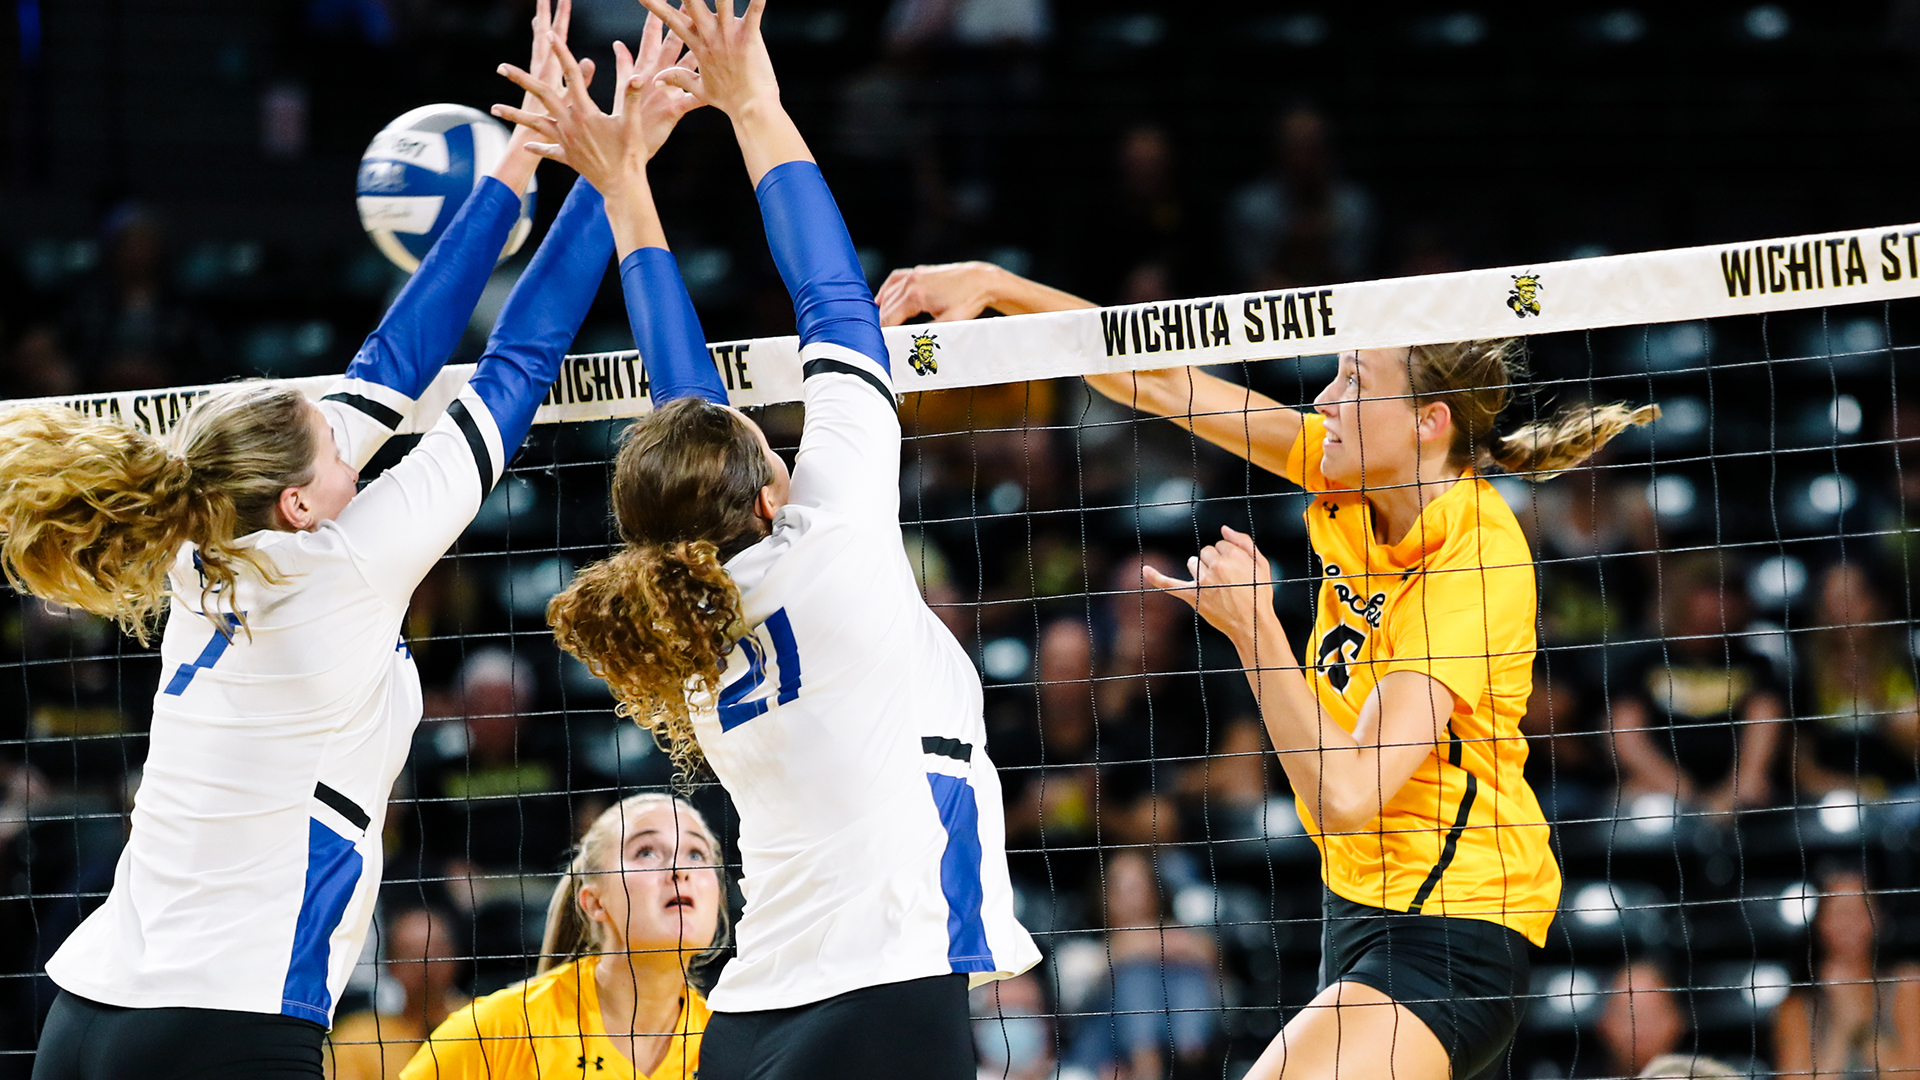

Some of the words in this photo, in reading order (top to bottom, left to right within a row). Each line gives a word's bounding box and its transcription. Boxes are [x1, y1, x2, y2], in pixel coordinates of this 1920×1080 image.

[1720, 236, 1868, 298] WICHITA
[1100, 300, 1231, 357] WICHITA
[1244, 289, 1336, 343] STATE
[163, 610, 248, 696] 7
[717, 606, 802, 734] 21
